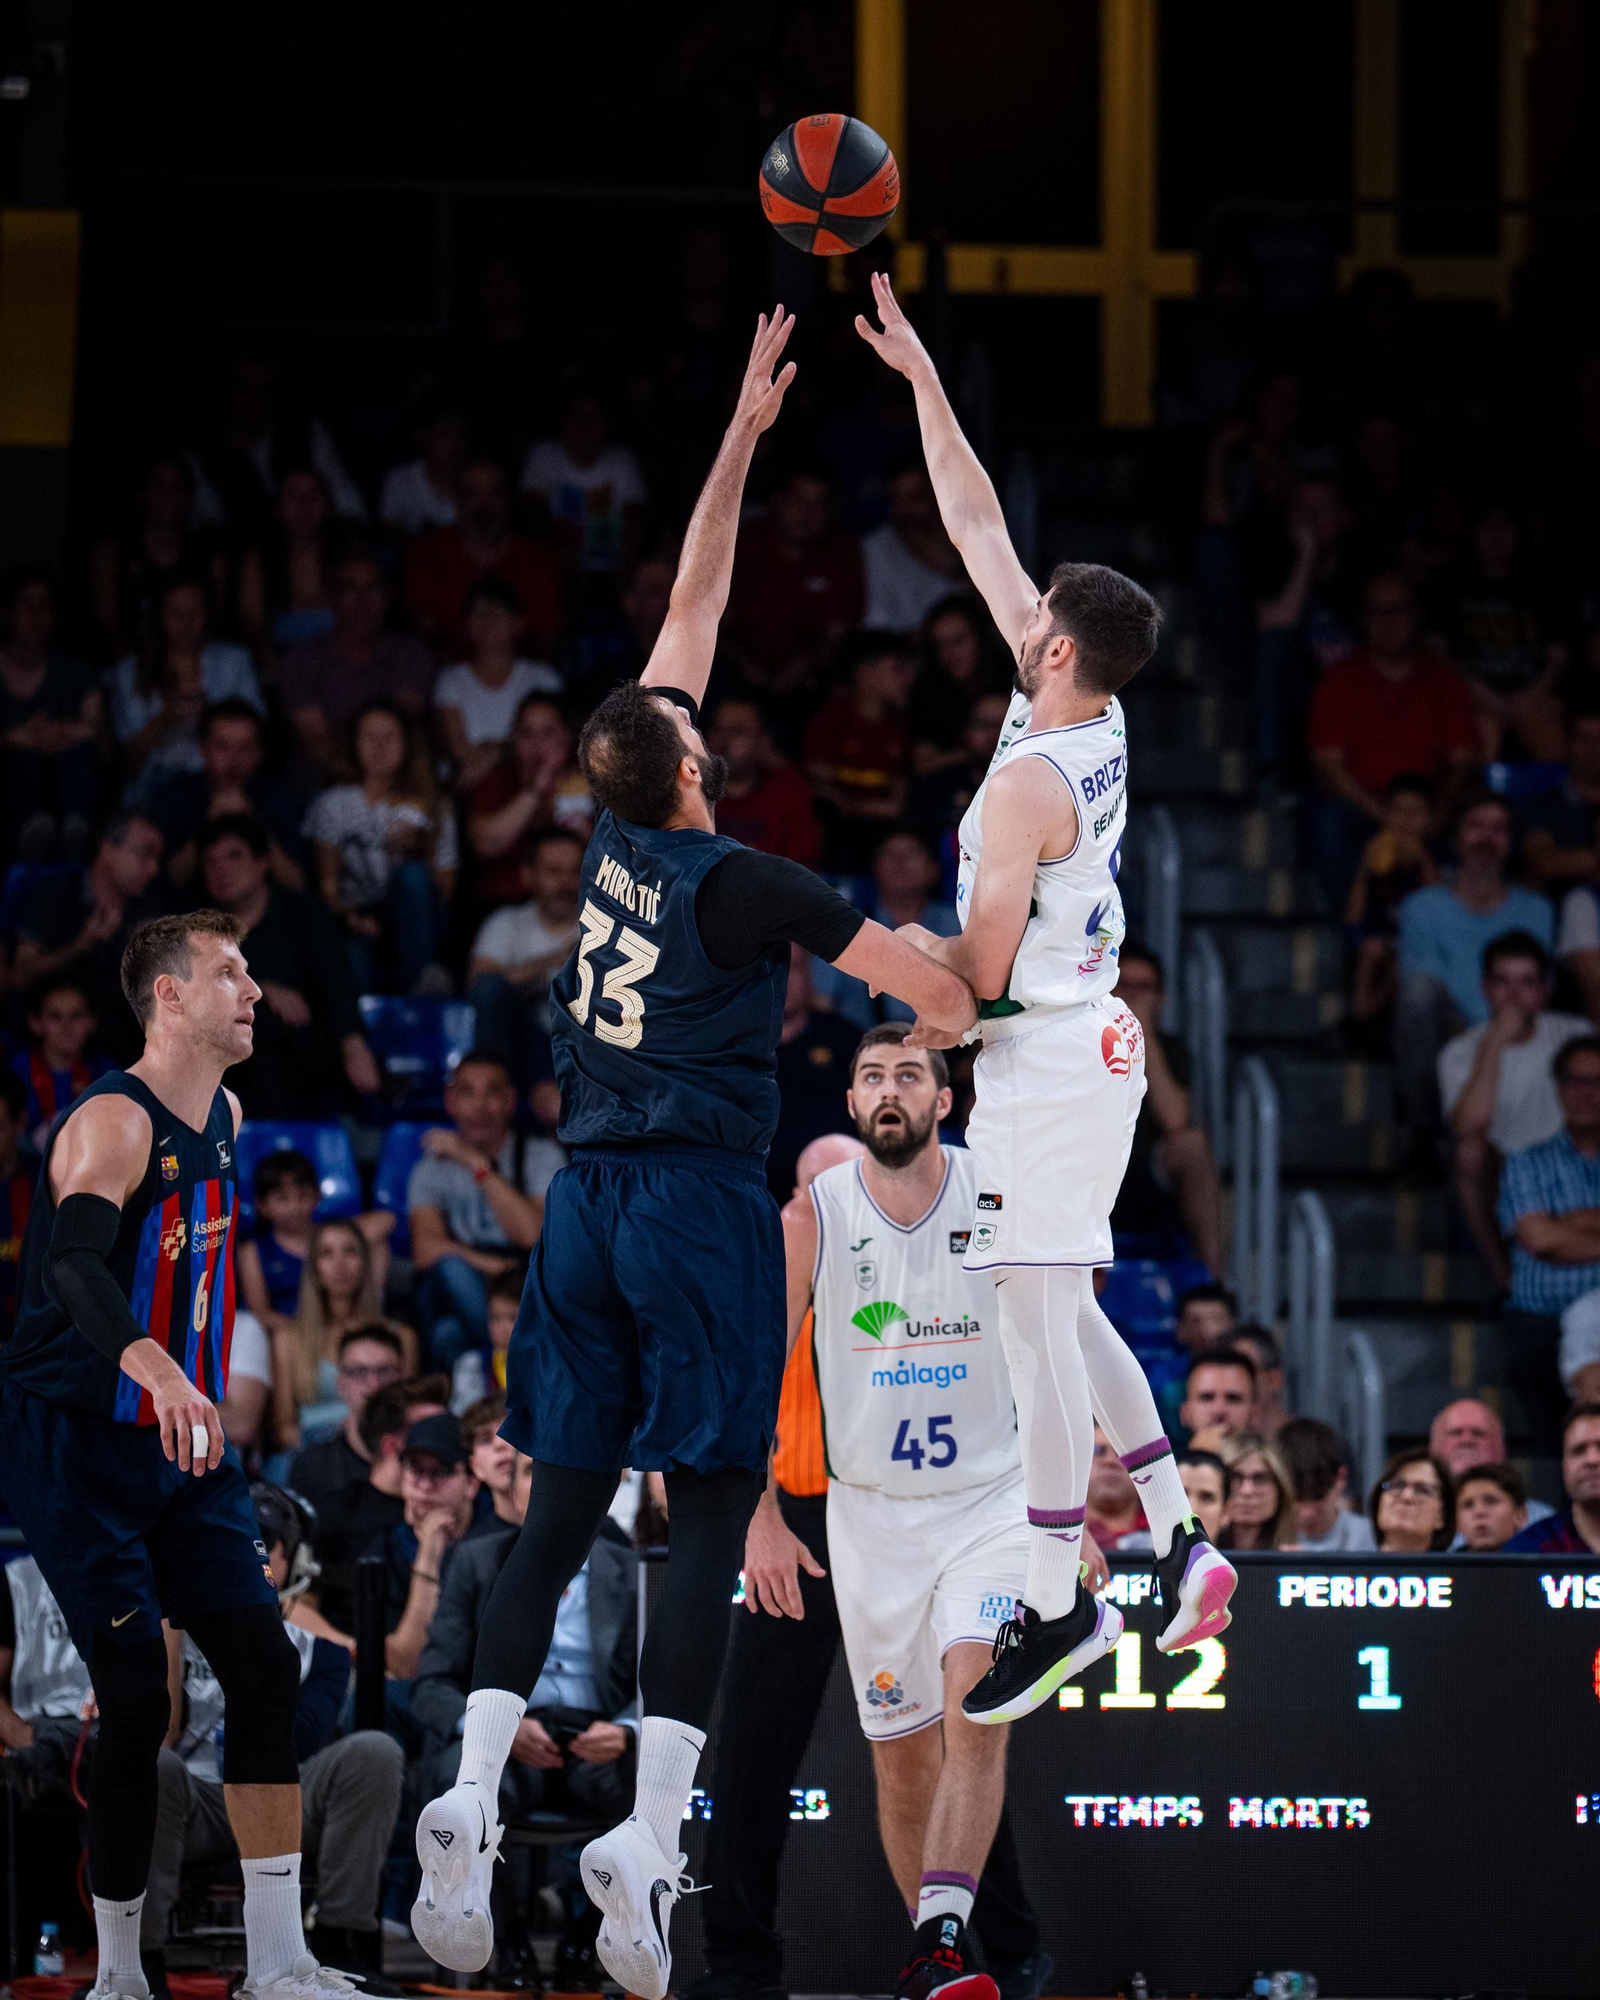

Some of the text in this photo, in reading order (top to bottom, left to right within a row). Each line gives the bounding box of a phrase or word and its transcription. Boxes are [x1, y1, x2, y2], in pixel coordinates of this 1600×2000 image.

[566, 897, 661, 1050] 33
[978, 1200, 997, 1209] acb
[193, 1270, 208, 1332] 6
[906, 1315, 981, 1338] Unicaja
[890, 1414, 958, 1470] 45
[1278, 1575, 1453, 1608] PERIODE
[1358, 1646, 1402, 1710] 1
[1228, 1796, 1372, 1829] MORTS
